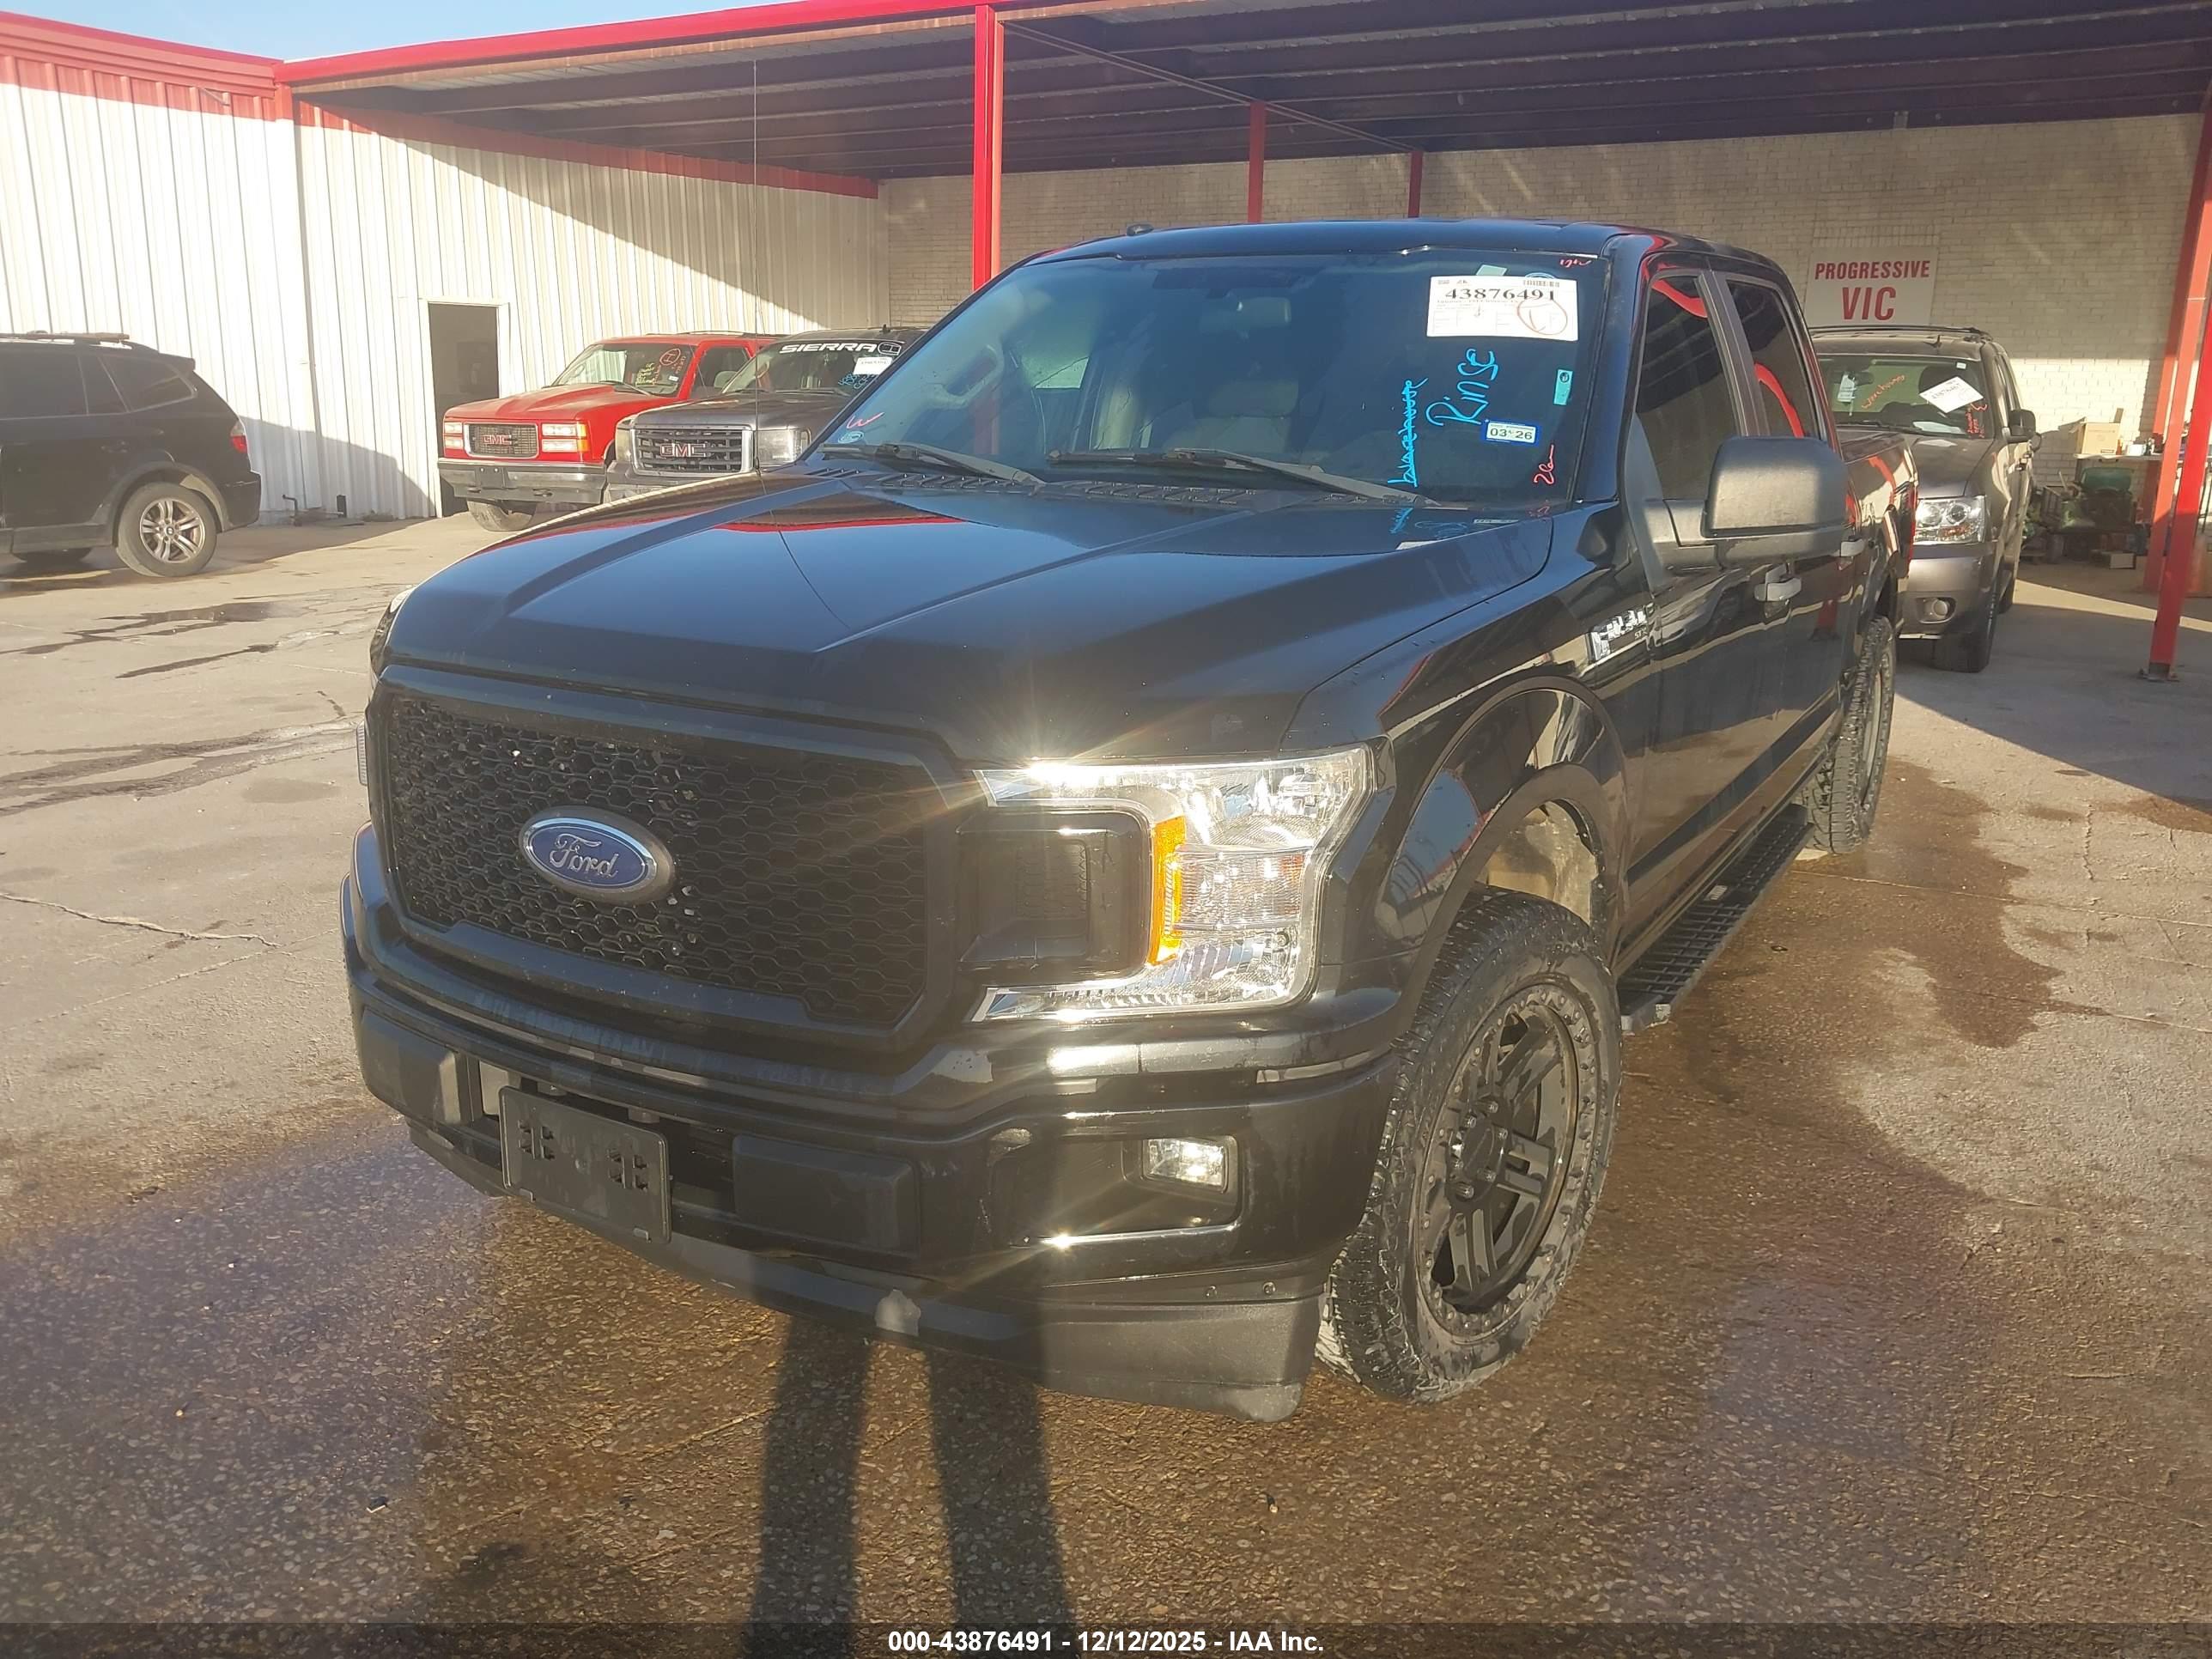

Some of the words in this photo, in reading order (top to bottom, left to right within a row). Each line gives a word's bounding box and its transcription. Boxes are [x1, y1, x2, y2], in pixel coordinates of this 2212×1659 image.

[1814, 260, 1930, 280] PROGRESSIVE
[1445, 288, 1555, 301] 43876491
[1841, 286, 1897, 321] VIC
[779, 343, 878, 354] SIERRA
[482, 434, 513, 446] GMC
[1490, 428, 1507, 437] 03
[1515, 430, 1533, 441] 26
[659, 443, 706, 458] GMC
[550, 833, 619, 878] Ford
